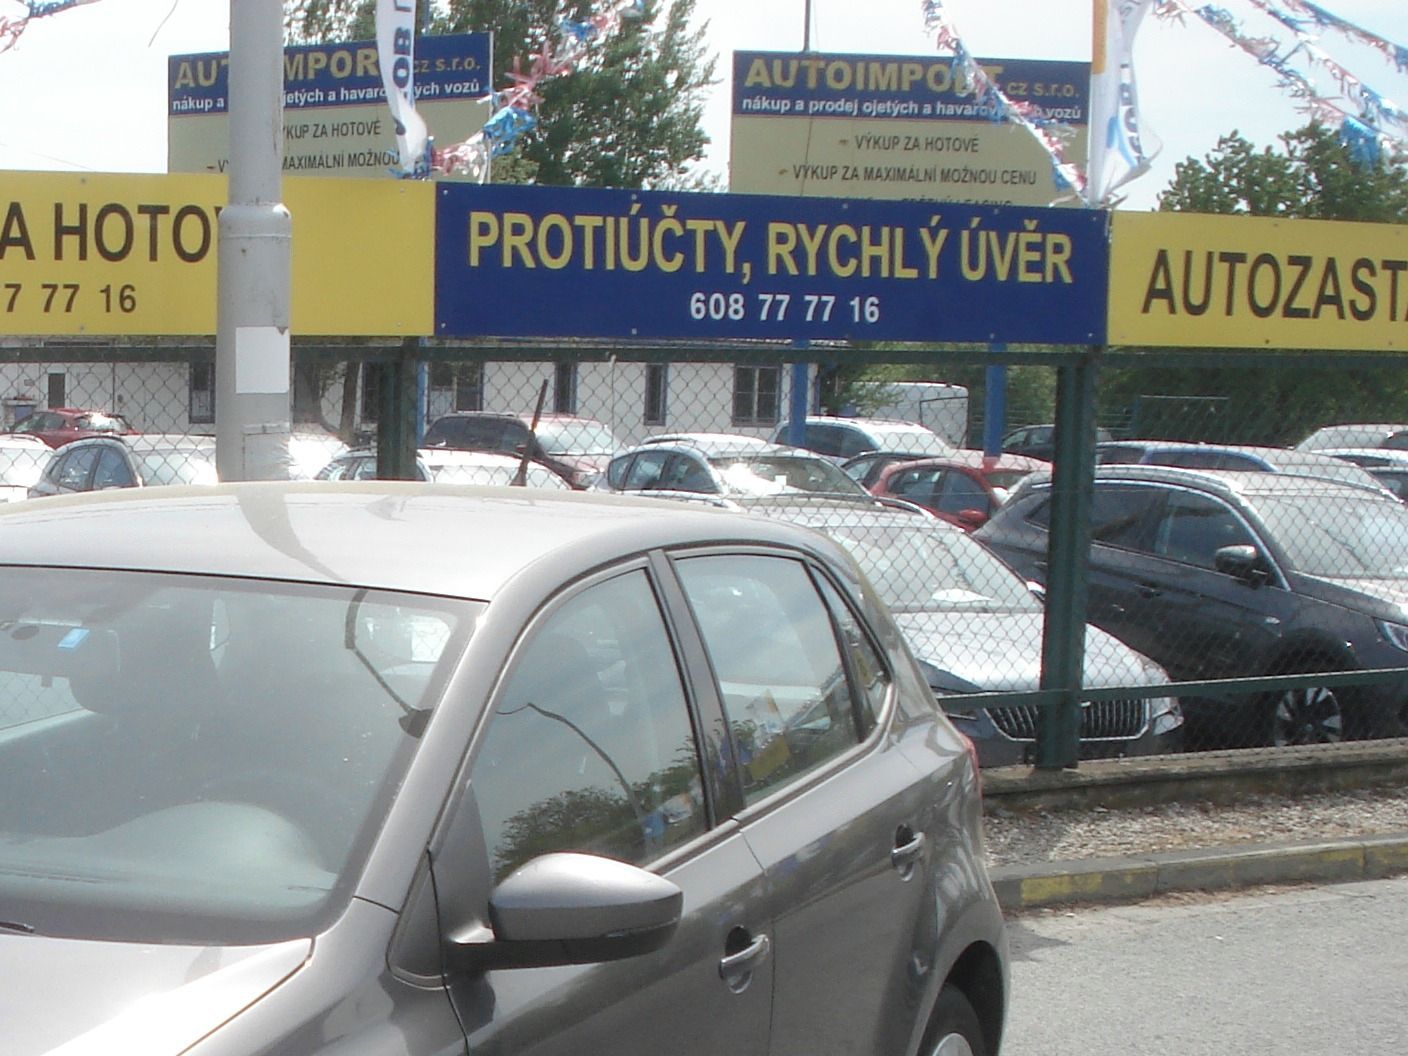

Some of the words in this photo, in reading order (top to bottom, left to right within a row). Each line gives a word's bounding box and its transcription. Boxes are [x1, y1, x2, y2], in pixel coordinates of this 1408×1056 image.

[436, 57, 481, 72] s.r.o.
[173, 95, 213, 112] nákup
[216, 97, 224, 108] a
[283, 88, 324, 106] jetých
[328, 92, 336, 102] a
[445, 78, 479, 94] vozů
[1007, 82, 1027, 95] cz
[1034, 83, 1079, 97] s.r.o.
[742, 97, 790, 114] nákup
[795, 100, 804, 111] a
[809, 98, 858, 116] prodej
[863, 99, 918, 117] ojetých
[923, 104, 932, 115] a
[1047, 105, 1080, 119] vozů
[282, 124, 309, 140] KUP
[312, 121, 327, 138] ZA
[855, 132, 899, 150] VÝKUP
[904, 135, 920, 151] ZA
[793, 162, 838, 180] VÝKUP
[842, 166, 859, 181] ZA
[863, 165, 937, 183] MAXIMÁLNÍ
[941, 165, 997, 184] MOŽNOU
[1001, 170, 1036, 185] CENU
[54, 202, 222, 263] HOTO
[469, 203, 751, 285] PROTIÚČTY,
[768, 215, 948, 279] RYCHLÝ
[961, 217, 1072, 283] ÚVĚR
[41, 283, 80, 313] 77
[100, 283, 136, 313] 16
[1141, 249, 1408, 322] AUTOZAST
[690, 293, 744, 320] 608
[758, 294, 790, 321] 77
[804, 295, 835, 322] 77
[850, 296, 880, 323] 16
